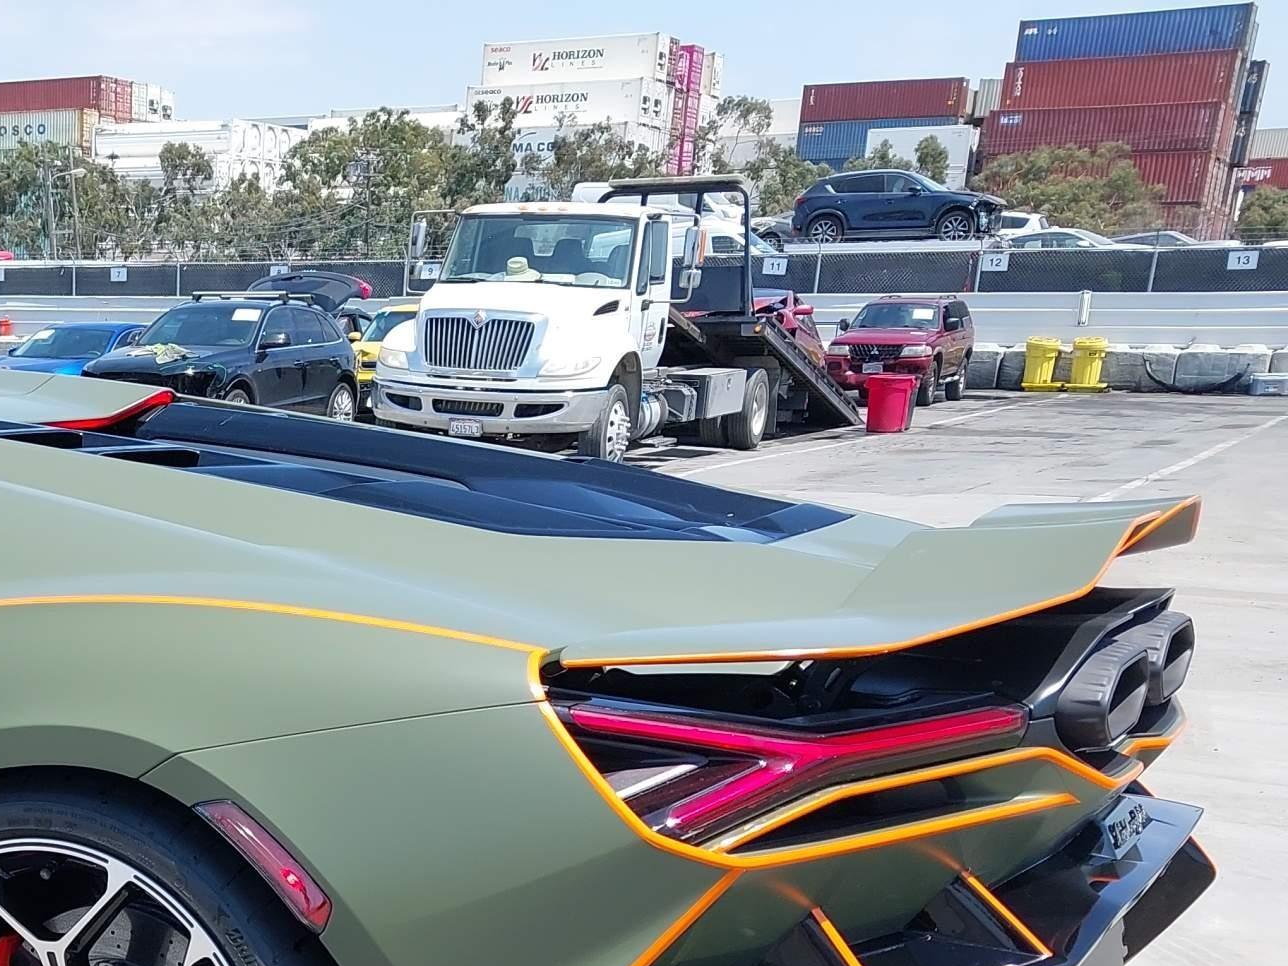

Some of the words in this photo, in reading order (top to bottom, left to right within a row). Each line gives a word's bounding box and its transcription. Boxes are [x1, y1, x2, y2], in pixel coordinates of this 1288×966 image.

[552, 48, 605, 61] HORIZON
[551, 60, 597, 68] LINES
[535, 92, 589, 105] HORIZON
[534, 103, 580, 112] LINES
[512, 142, 533, 153] MA
[537, 141, 555, 152] CG
[988, 258, 1002, 267] 12
[1237, 255, 1251, 265] 13
[427, 266, 434, 276] 9
[769, 262, 781, 271] 11
[116, 270, 122, 280] 7
